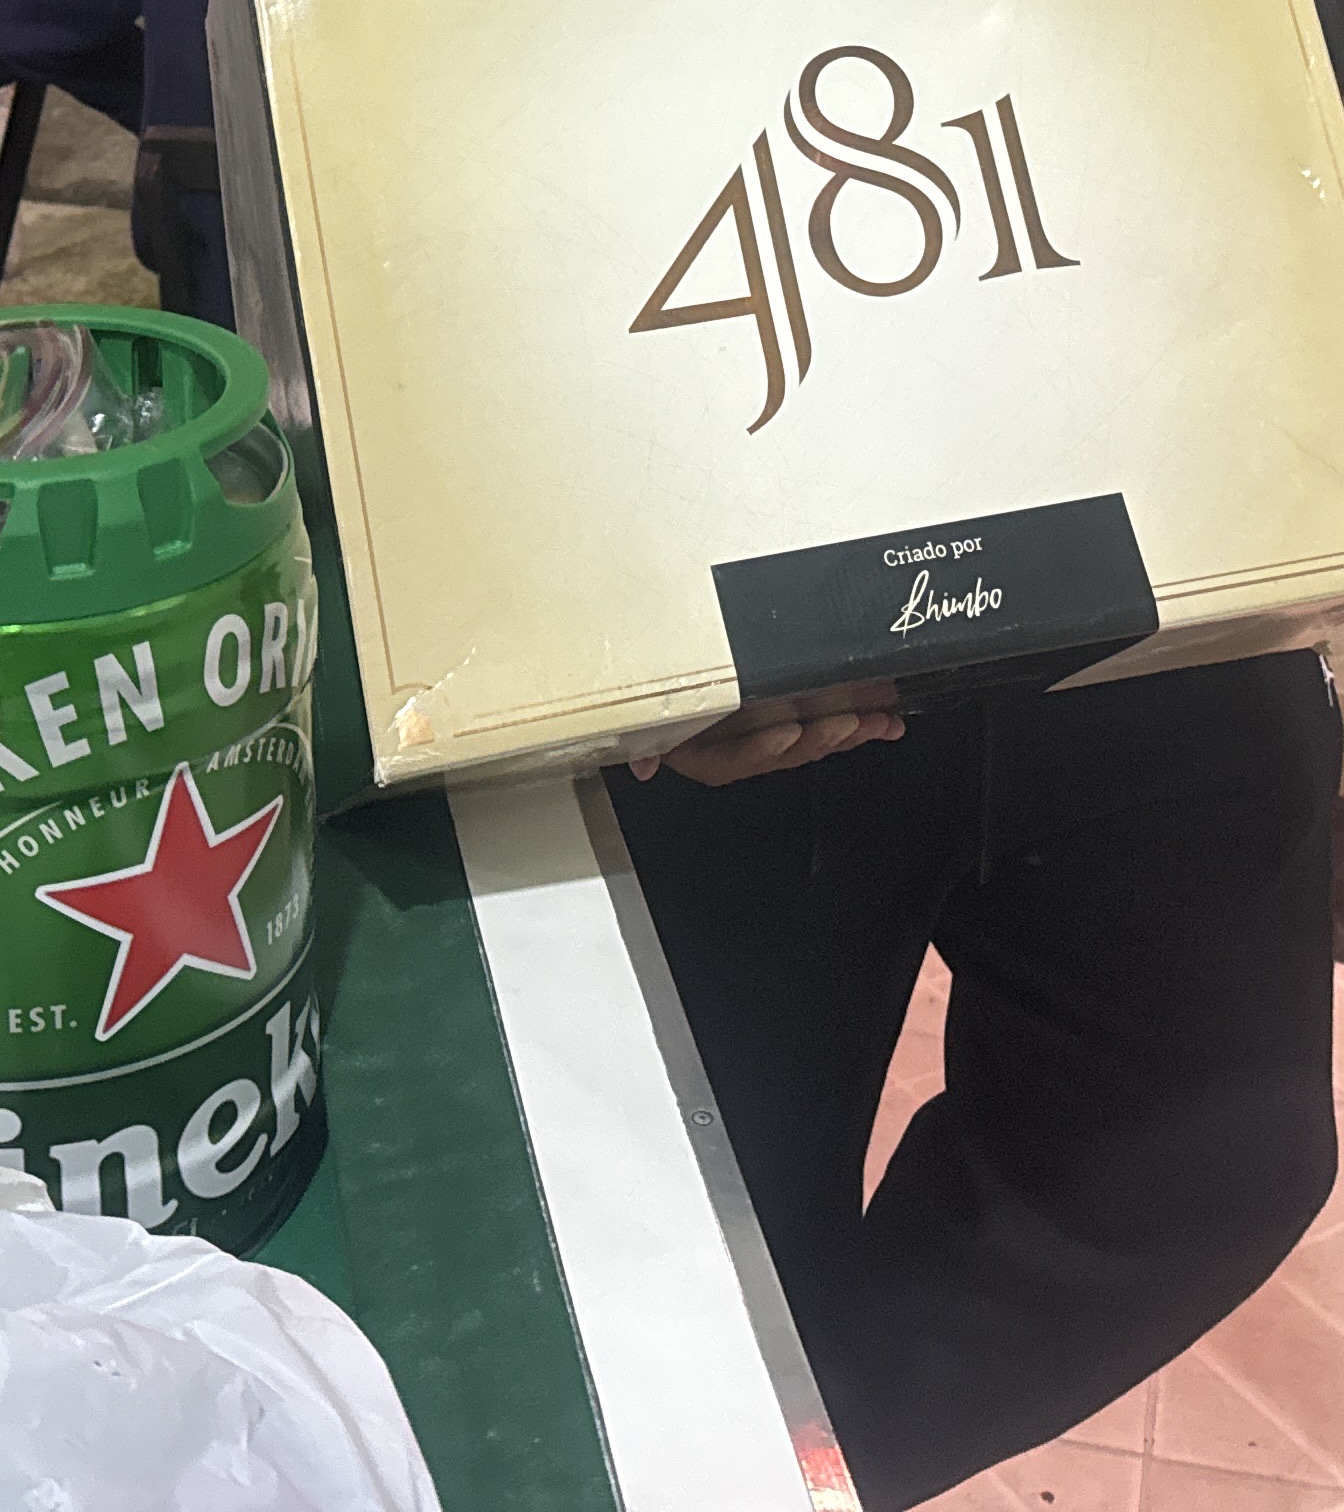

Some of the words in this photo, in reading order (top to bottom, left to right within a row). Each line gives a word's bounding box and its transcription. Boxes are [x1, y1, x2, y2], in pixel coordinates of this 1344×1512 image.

[629, 45, 1081, 436] 481
[883, 541, 947, 567] Criado
[950, 537, 983, 559] por
[8, 1004, 78, 1034] EST.
[267, 893, 299, 946] 1873
